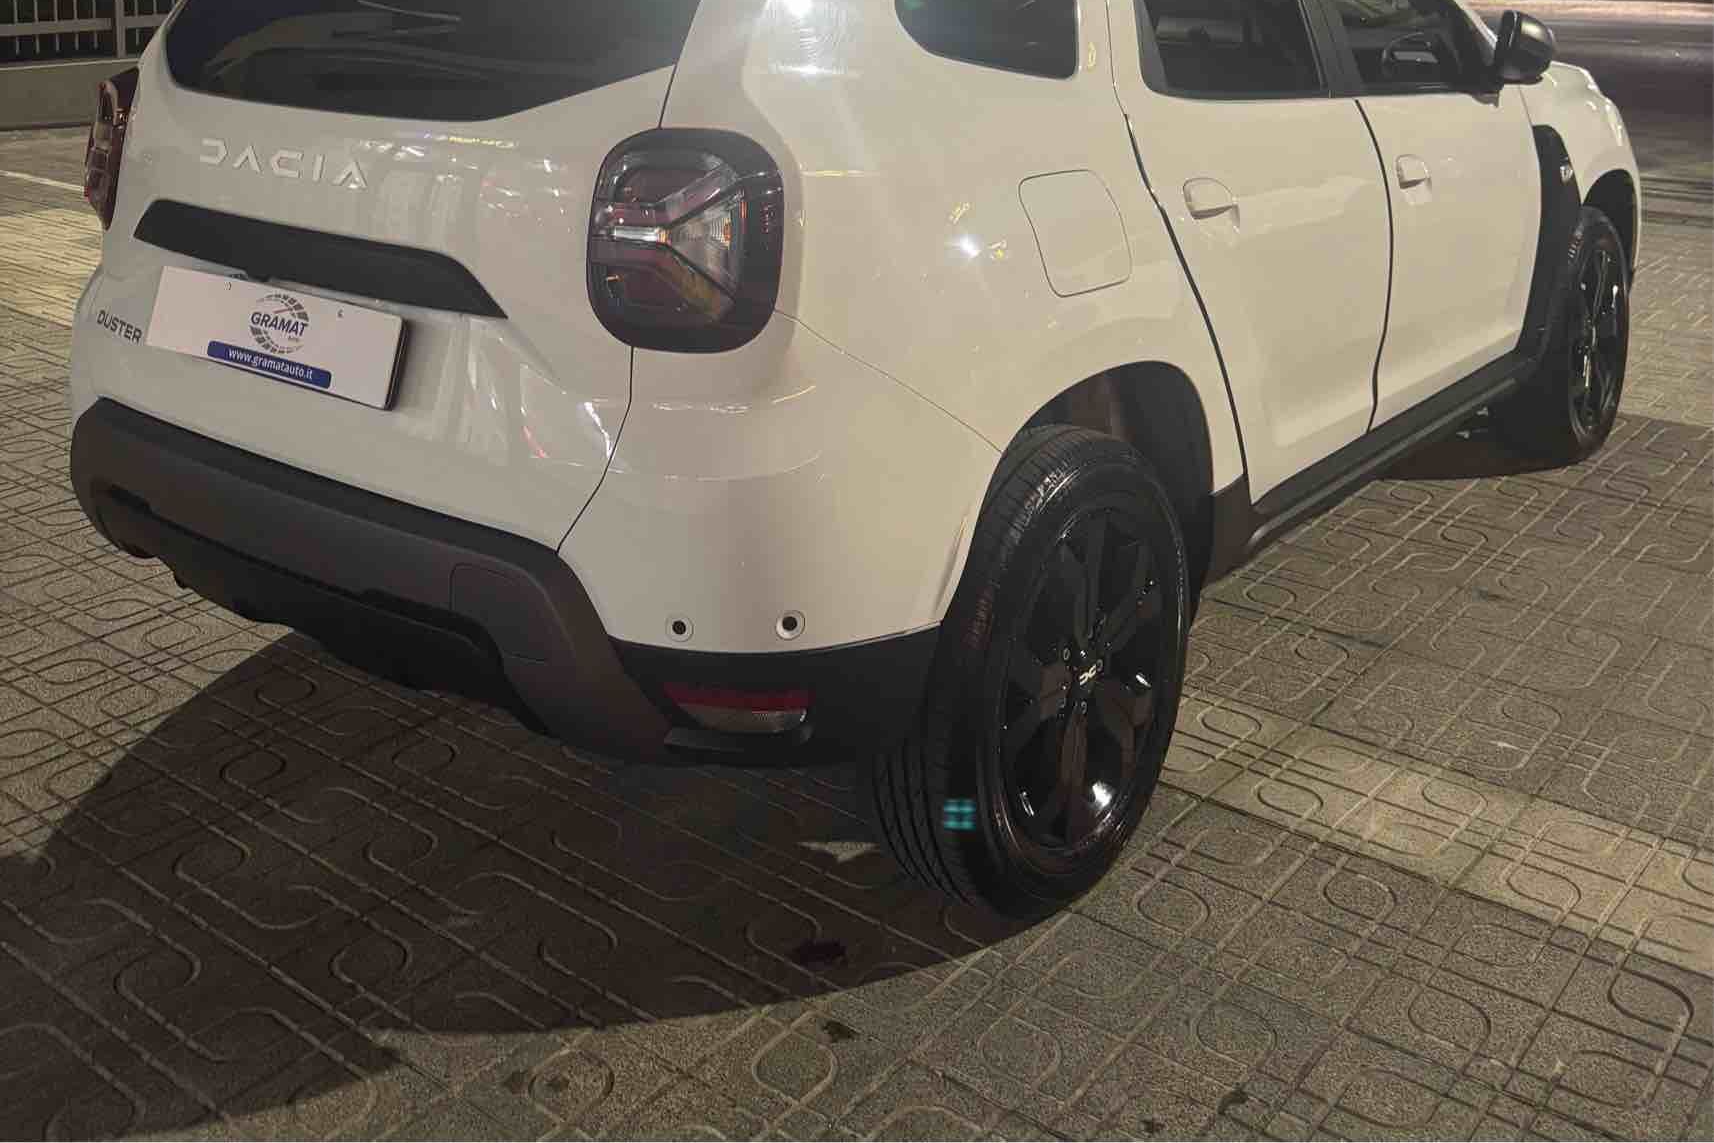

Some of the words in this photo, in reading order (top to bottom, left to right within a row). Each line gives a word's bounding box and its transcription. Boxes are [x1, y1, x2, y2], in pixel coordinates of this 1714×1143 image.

[199, 138, 368, 189] DACIA
[96, 309, 142, 343] DUSTER
[250, 312, 309, 336] GRAMAT
[228, 349, 313, 380] www.gramatauto.it
